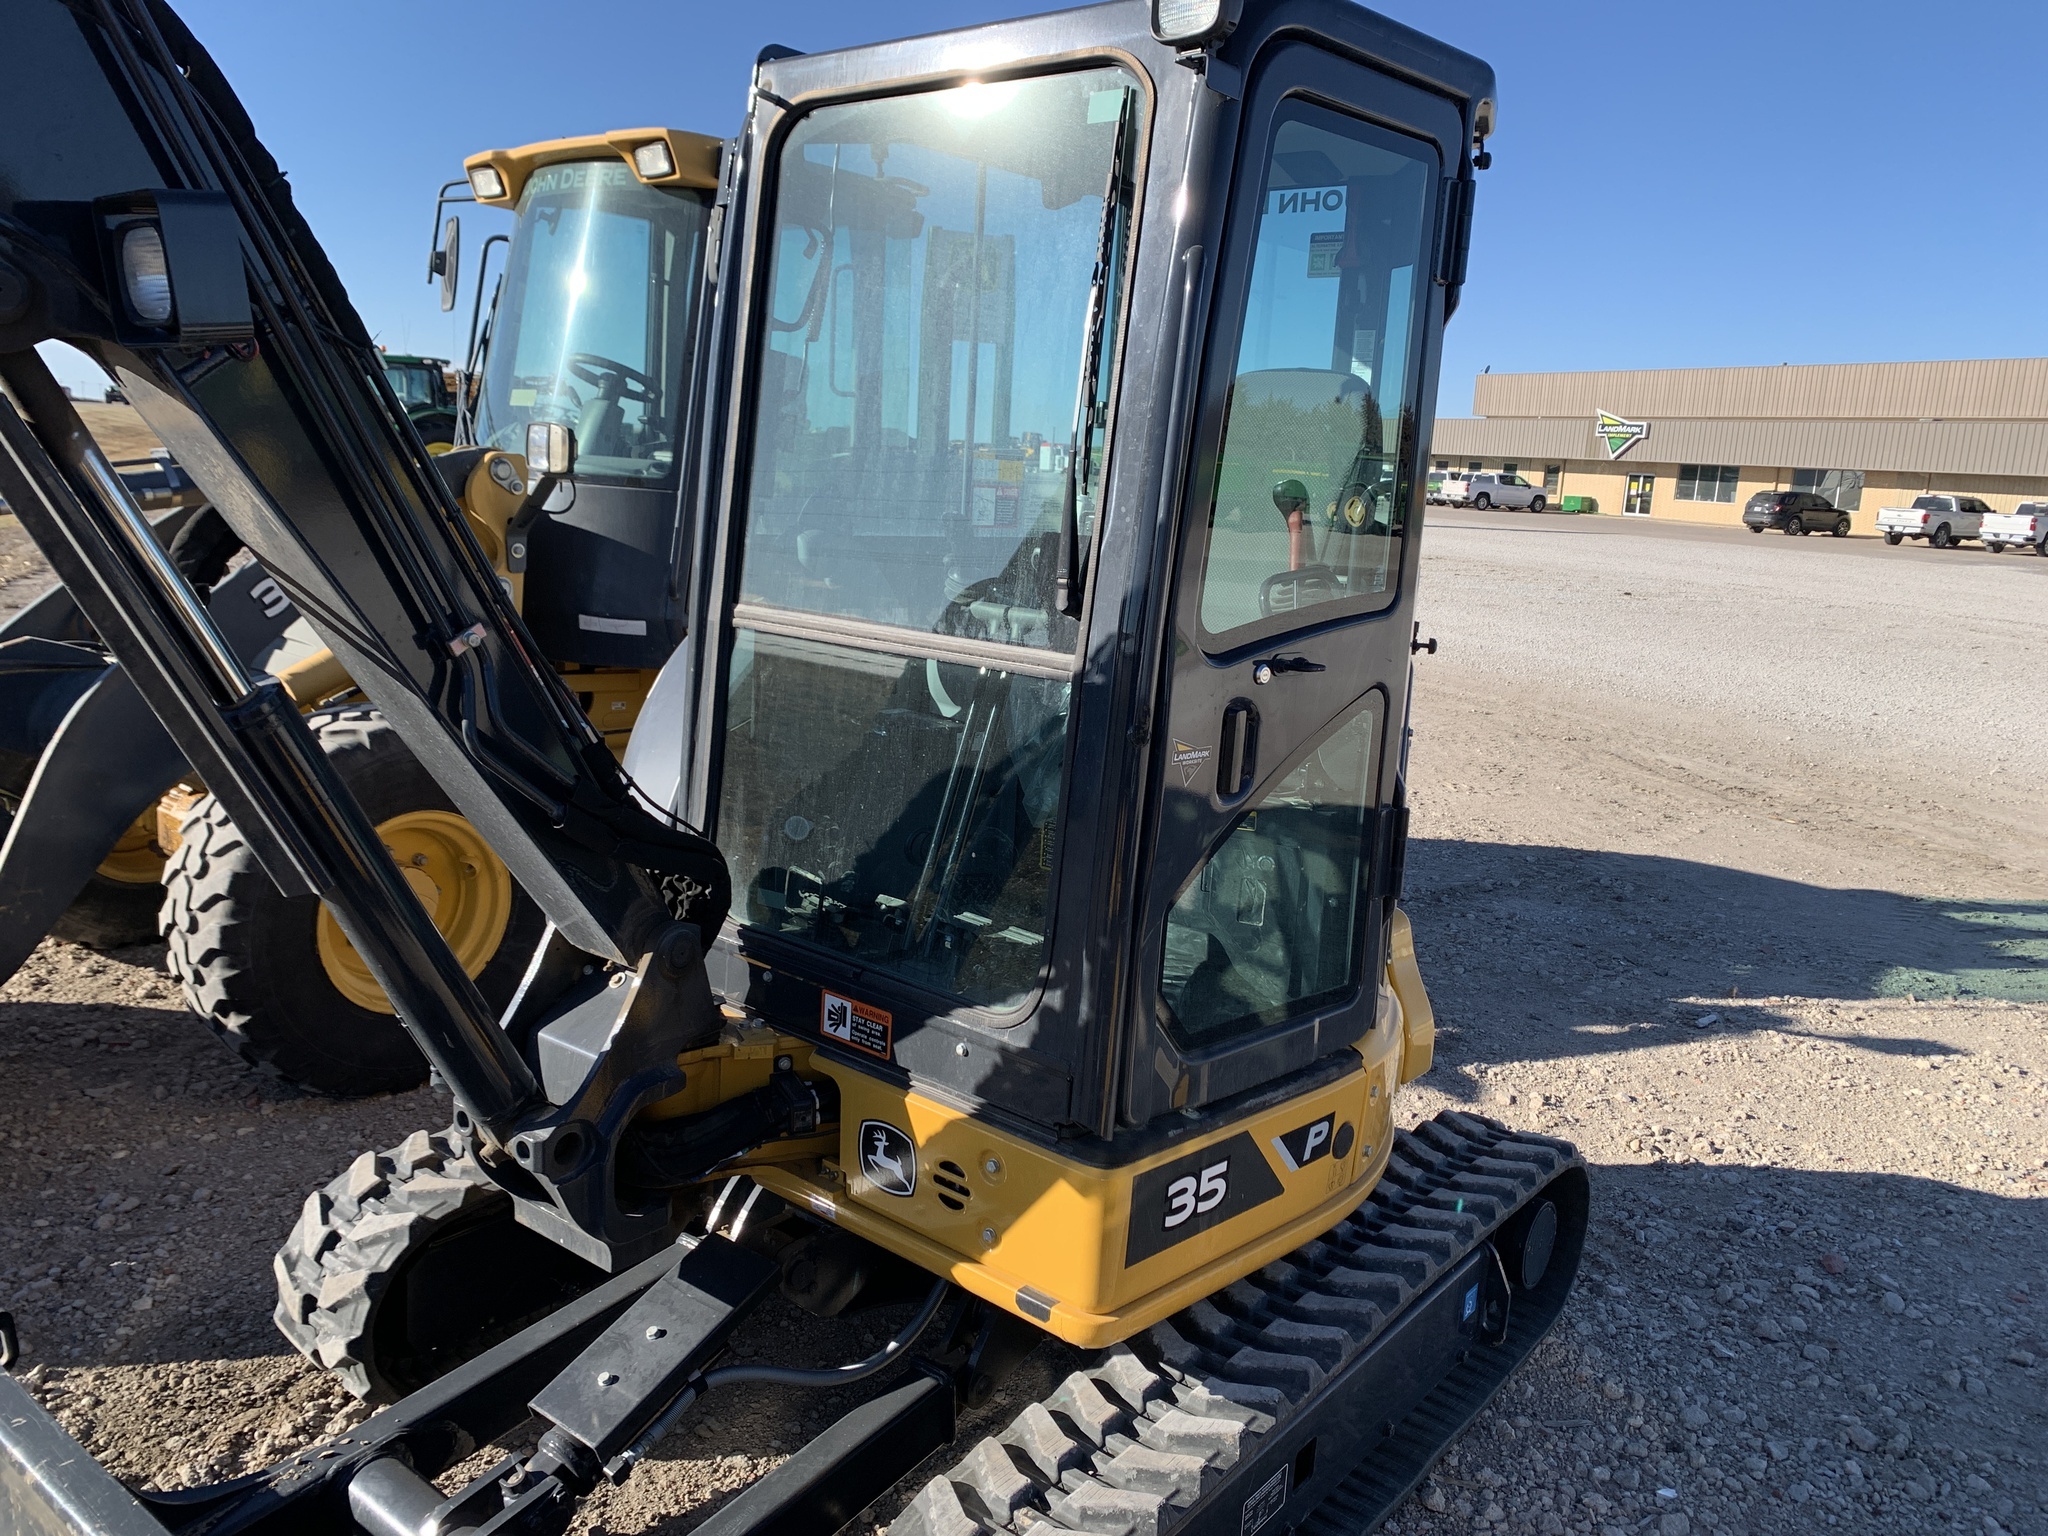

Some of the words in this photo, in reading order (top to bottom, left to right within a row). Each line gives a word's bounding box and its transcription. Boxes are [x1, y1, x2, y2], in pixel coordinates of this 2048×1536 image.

[525, 173, 558, 196] JOHN
[560, 167, 628, 189] DEERE
[1598, 425, 1642, 433] LANDMARK
[1174, 750, 1210, 761] LANDMARK
[852, 1015, 865, 1025] STAY
[866, 1020, 884, 1032] CLEAR
[859, 1006, 889, 1024] WARNING
[851, 1029, 867, 1039] Operate
[1164, 1158, 1229, 1229] 35
[1302, 1120, 1330, 1162] P
